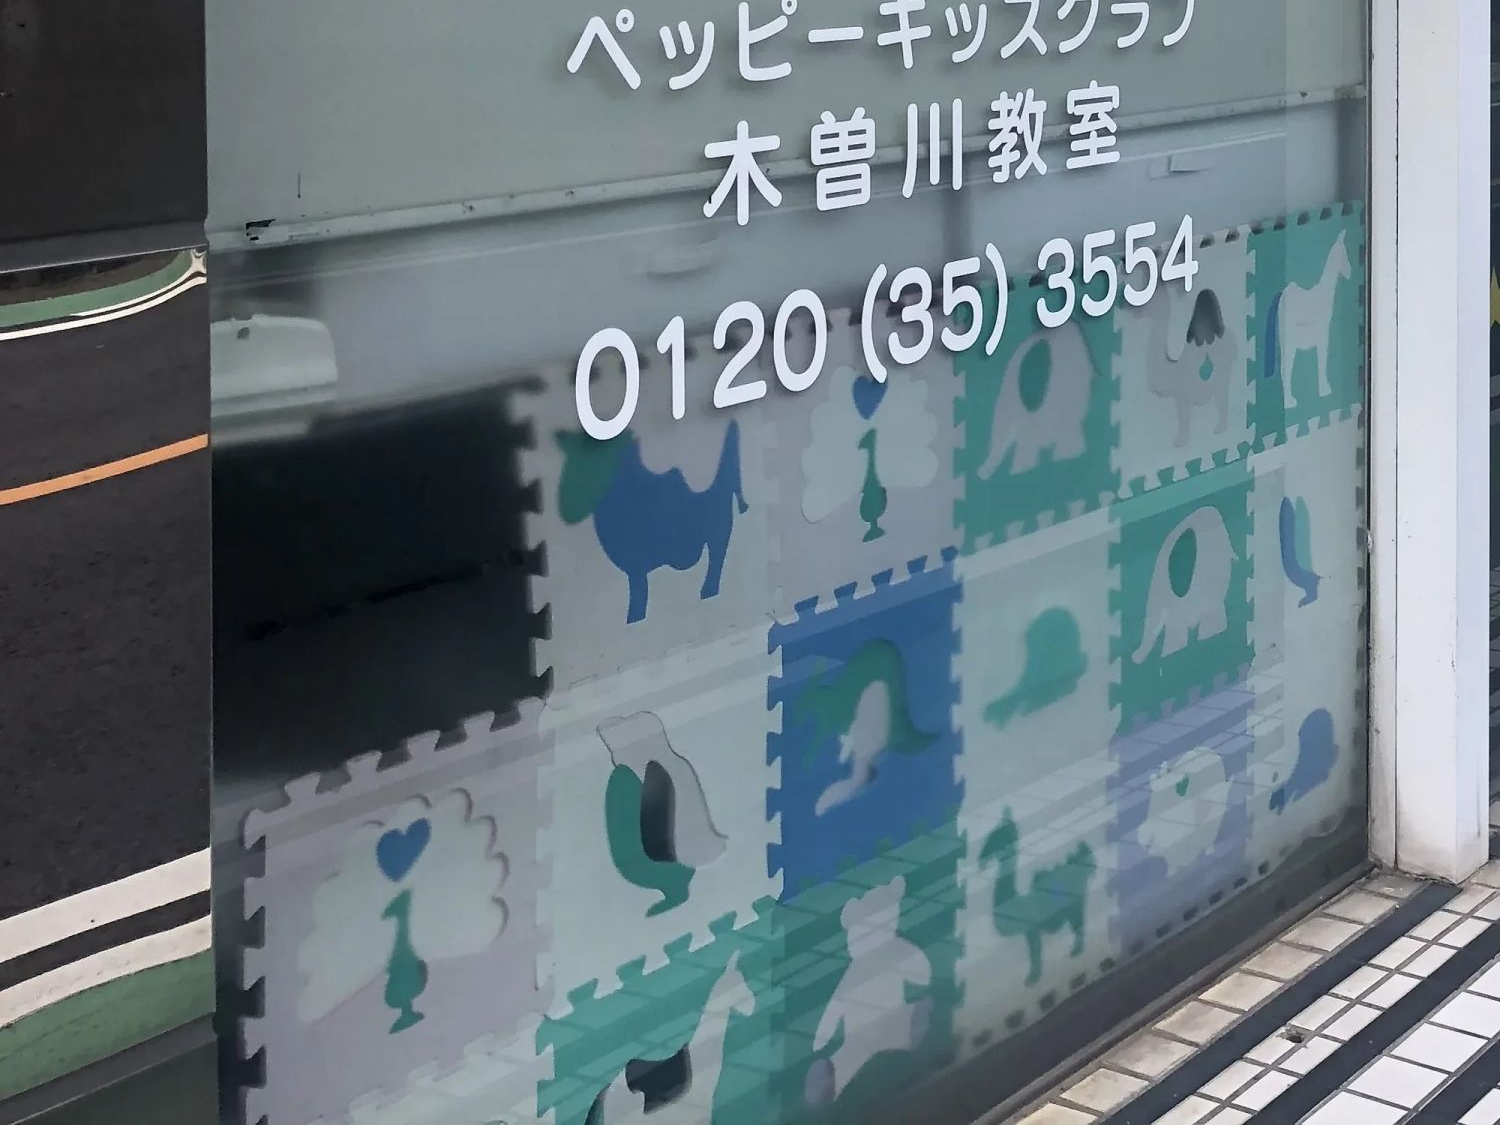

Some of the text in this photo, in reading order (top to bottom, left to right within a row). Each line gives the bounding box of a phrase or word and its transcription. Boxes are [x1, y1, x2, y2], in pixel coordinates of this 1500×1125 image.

[701, 80, 1122, 225] 木曽川教室
[574, 213, 1201, 442] 0120 (35) 3554
